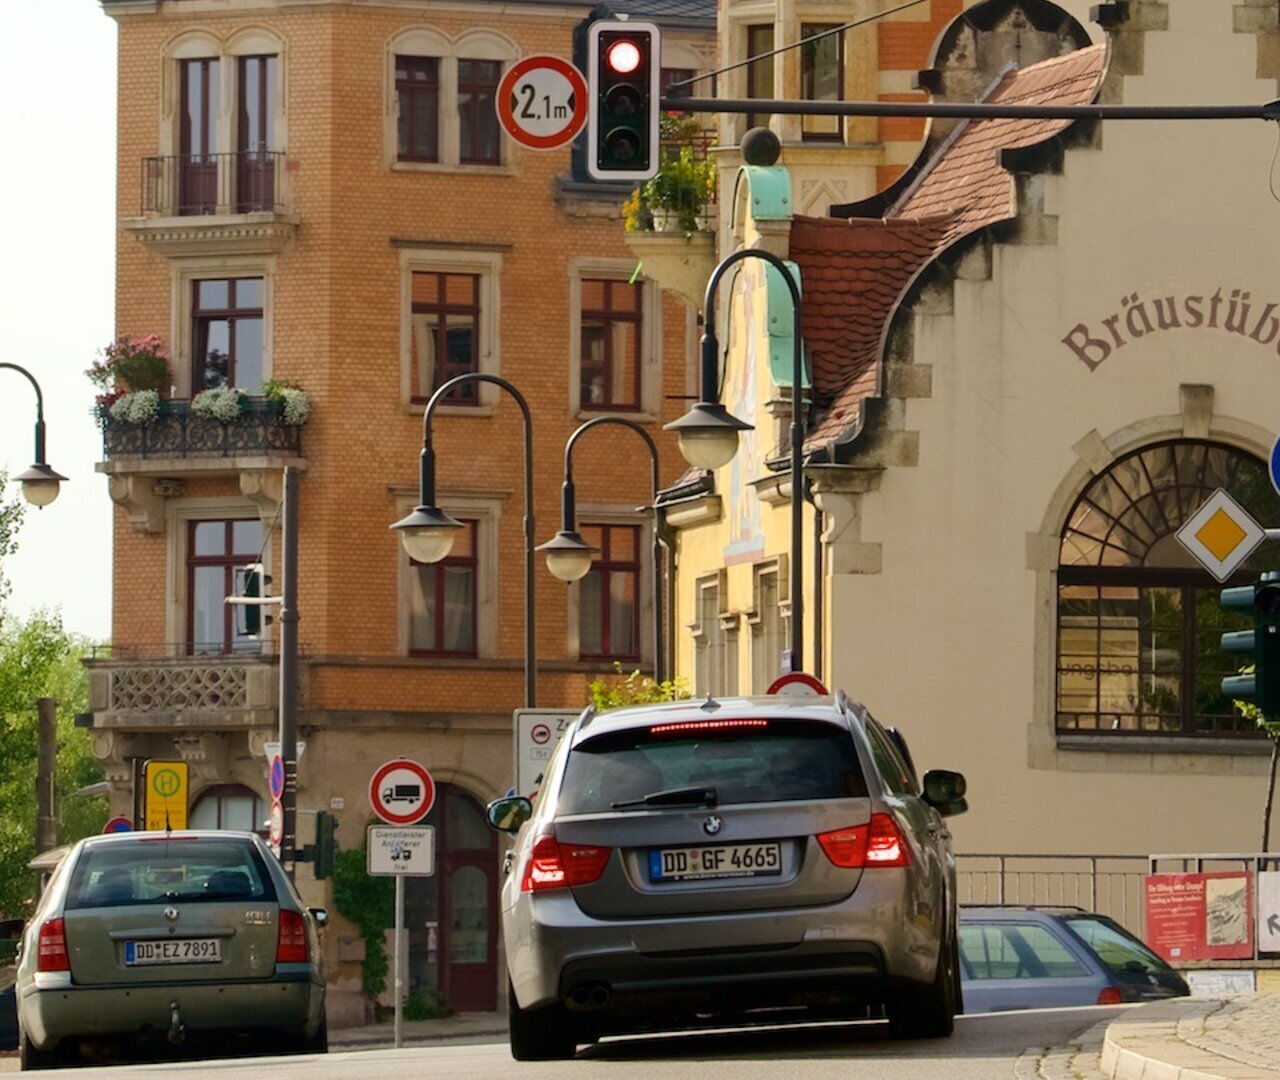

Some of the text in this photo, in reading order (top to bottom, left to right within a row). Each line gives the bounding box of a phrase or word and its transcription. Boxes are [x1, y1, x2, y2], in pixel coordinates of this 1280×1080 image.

[663, 846, 777, 873] DD GF 4665
[137, 941, 218, 958] DD EZ 7891
